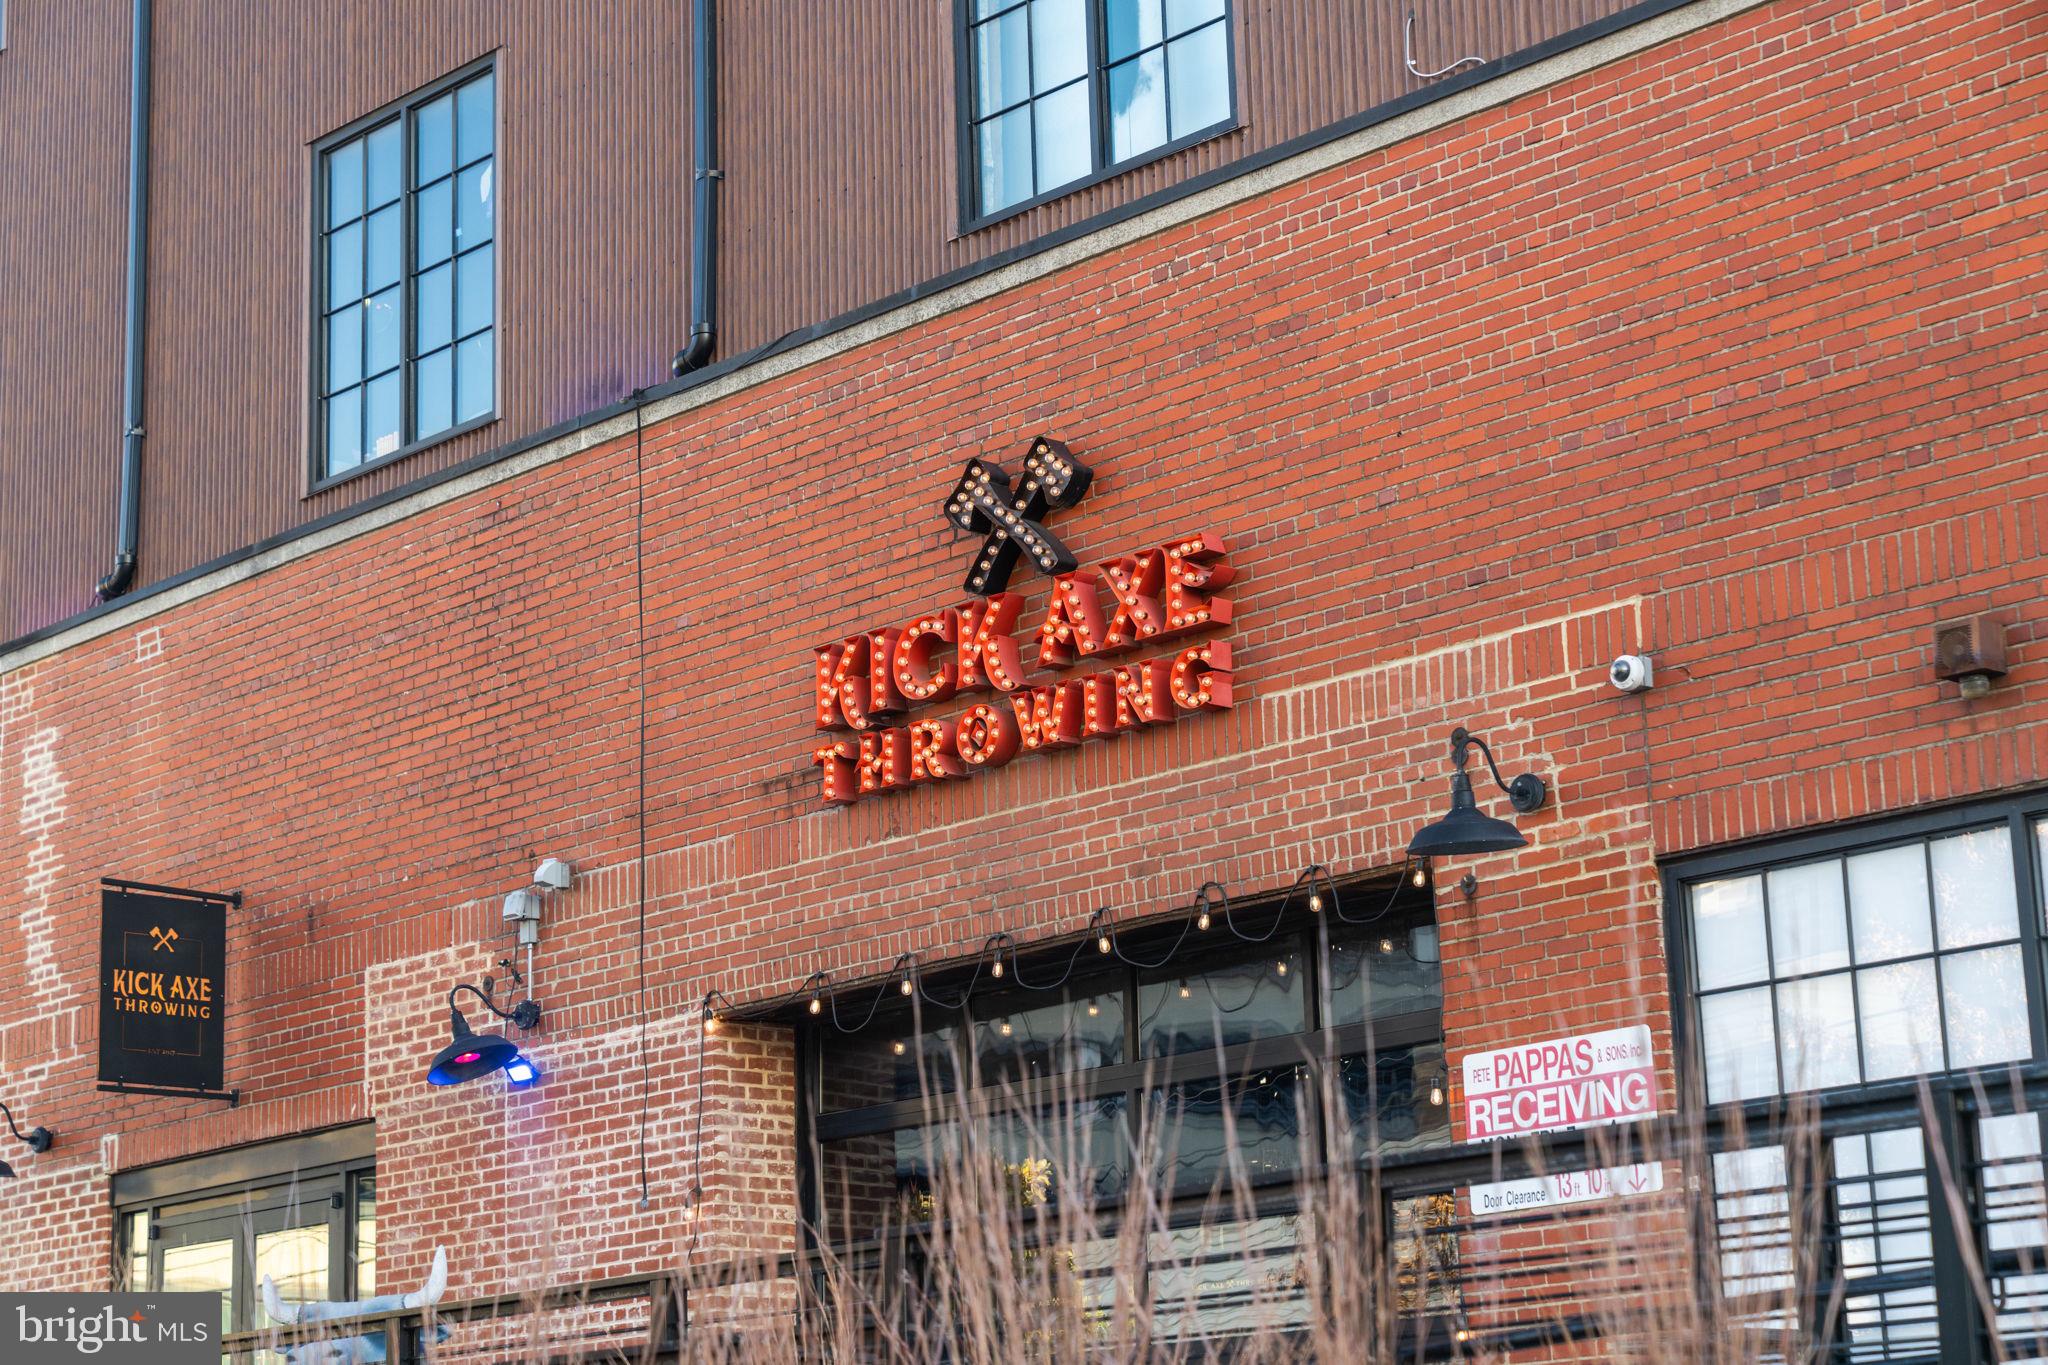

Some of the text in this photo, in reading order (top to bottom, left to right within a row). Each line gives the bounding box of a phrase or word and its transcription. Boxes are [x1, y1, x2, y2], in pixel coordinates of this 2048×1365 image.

[813, 532, 1239, 731] KICK AXE
[813, 639, 1236, 805] THROWING
[113, 968, 212, 1002] KICK AXE
[113, 997, 211, 1019] THROWING
[1472, 1067, 1491, 1083] PETE
[1493, 1039, 1594, 1089] PAPPAS
[1597, 1048, 1603, 1063] &
[1468, 1072, 1649, 1135] RECEIVING
[1483, 1193, 1503, 1209] Door
[1507, 1188, 1546, 1206] Clearance
[1555, 1170, 1573, 1199] 13
[1585, 1168, 1603, 1195] 10
